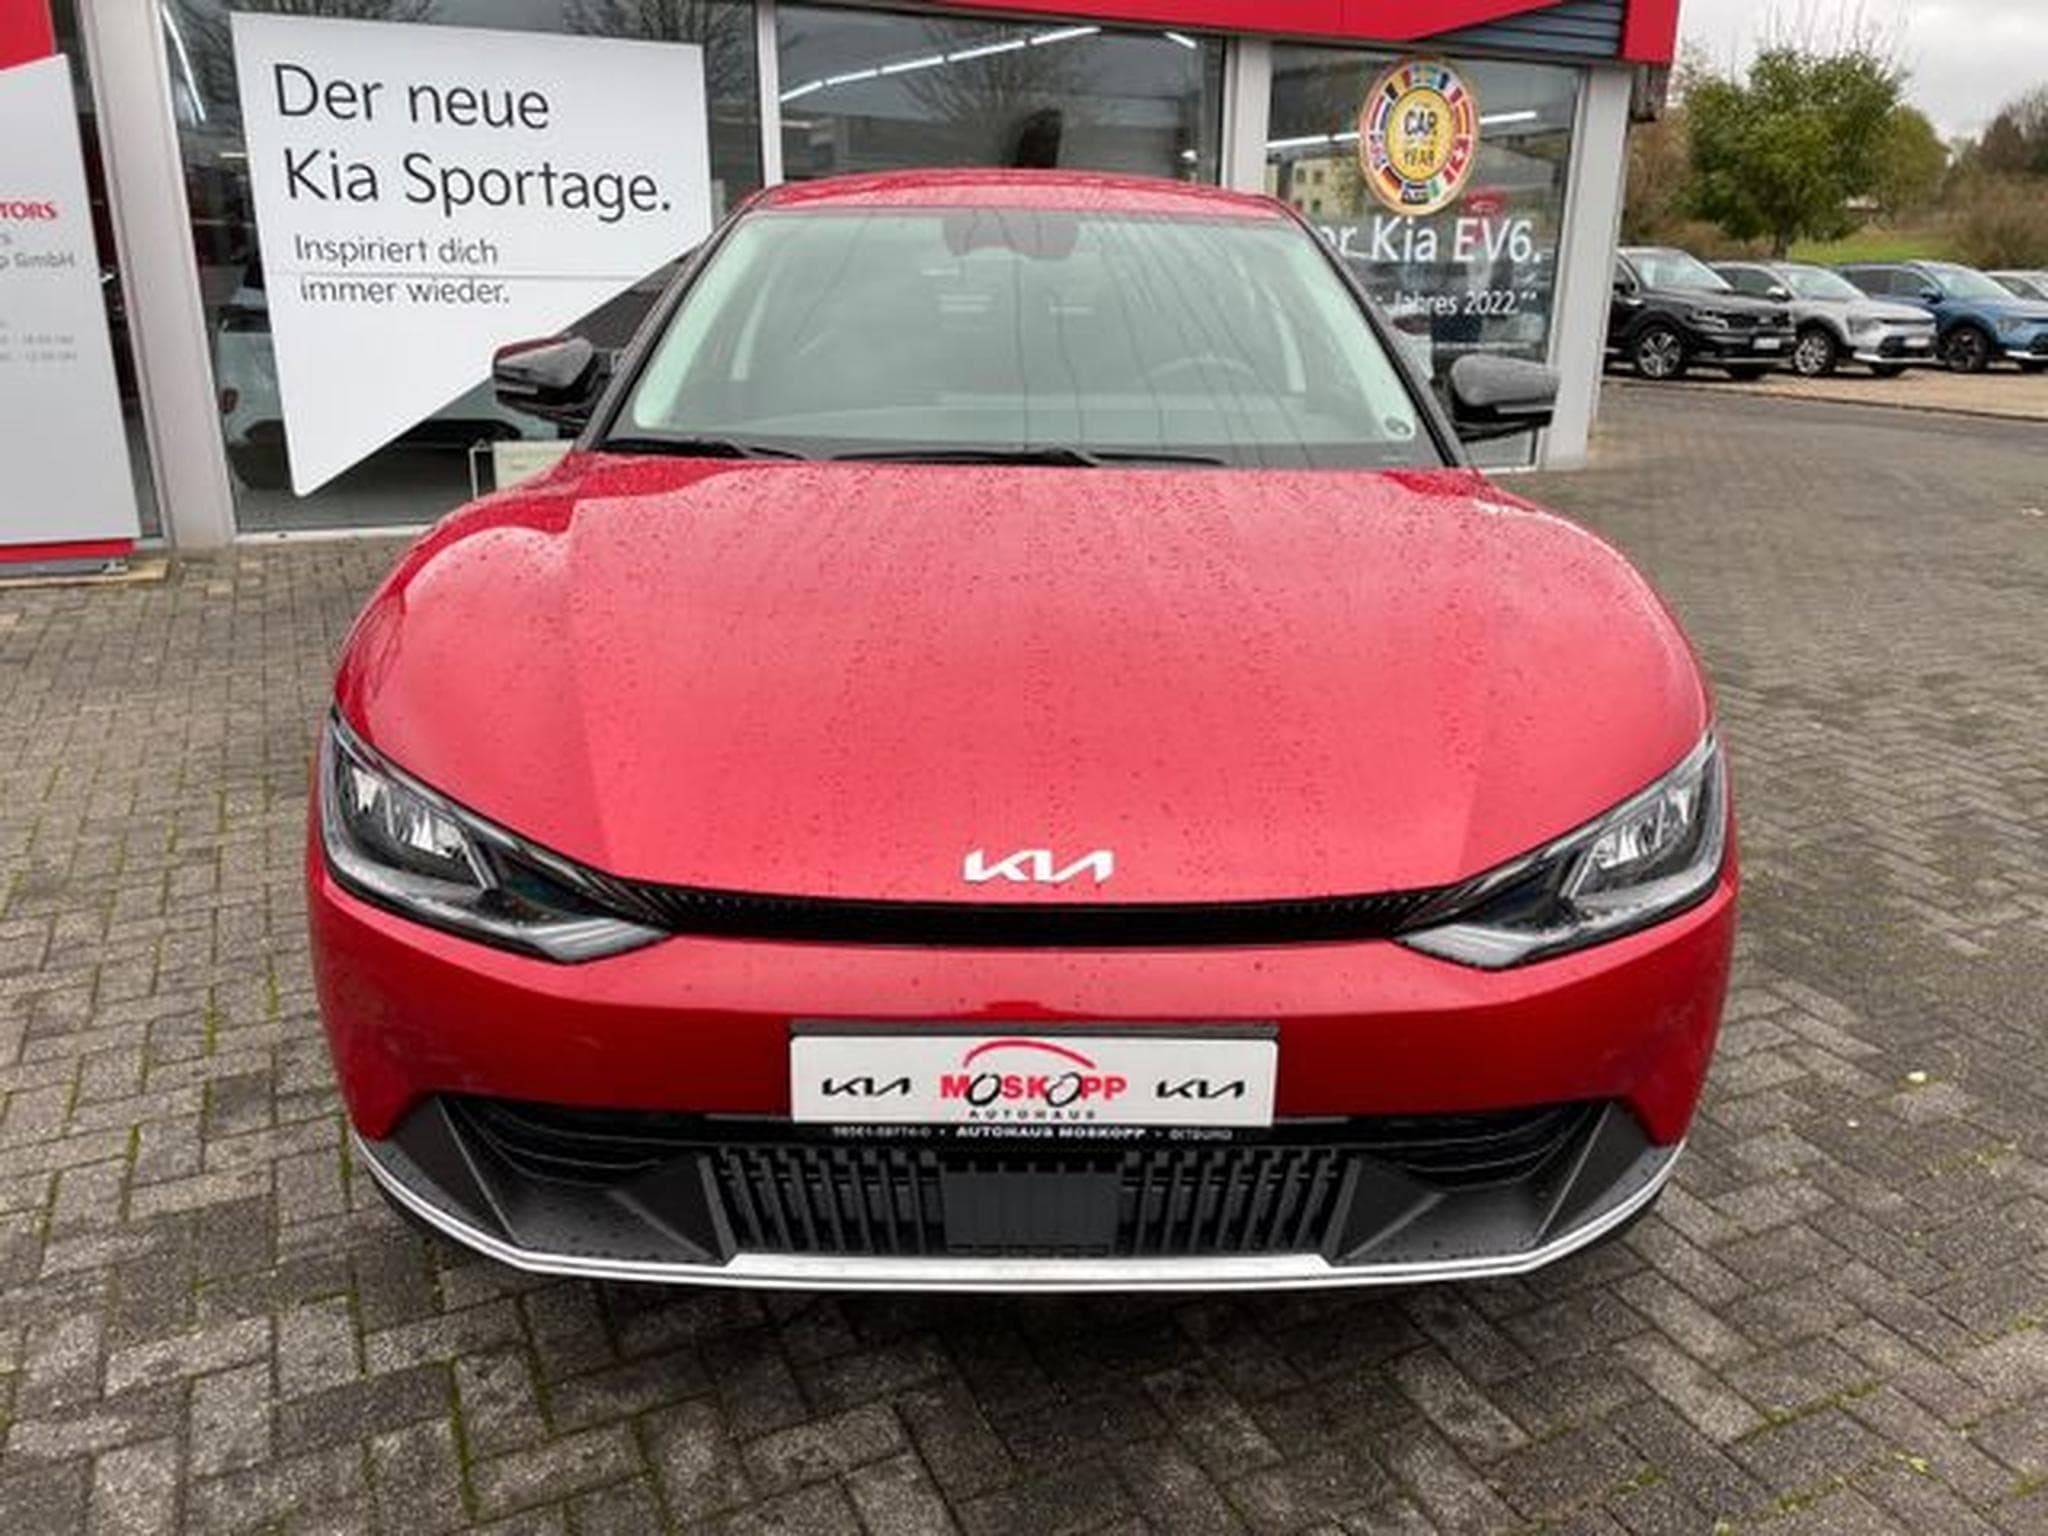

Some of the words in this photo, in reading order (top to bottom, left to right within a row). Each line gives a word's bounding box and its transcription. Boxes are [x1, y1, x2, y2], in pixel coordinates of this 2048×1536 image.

[274, 63, 384, 120] Der
[408, 82, 550, 129] neue
[284, 147, 379, 201] Kia
[403, 151, 671, 223] Sportage.
[295, 234, 427, 267] Inspiriert
[438, 237, 499, 265] dich
[1371, 214, 1438, 262] Kia
[1453, 217, 1542, 263] EV6.
[301, 278, 397, 303] immer
[406, 279, 510, 304] wieder.
[1393, 290, 1458, 316] Jahres
[962, 849, 1115, 884] KIA
[822, 1077, 911, 1097] KIA
[939, 1072, 1128, 1107] MOSKOPP
[1156, 1078, 1245, 1099] KIA
[969, 1109, 1096, 1120] AUTOHAUS
[955, 1125, 1055, 1139] AUTOHAUS
[1058, 1126, 1147, 1140] MOSKOPP
